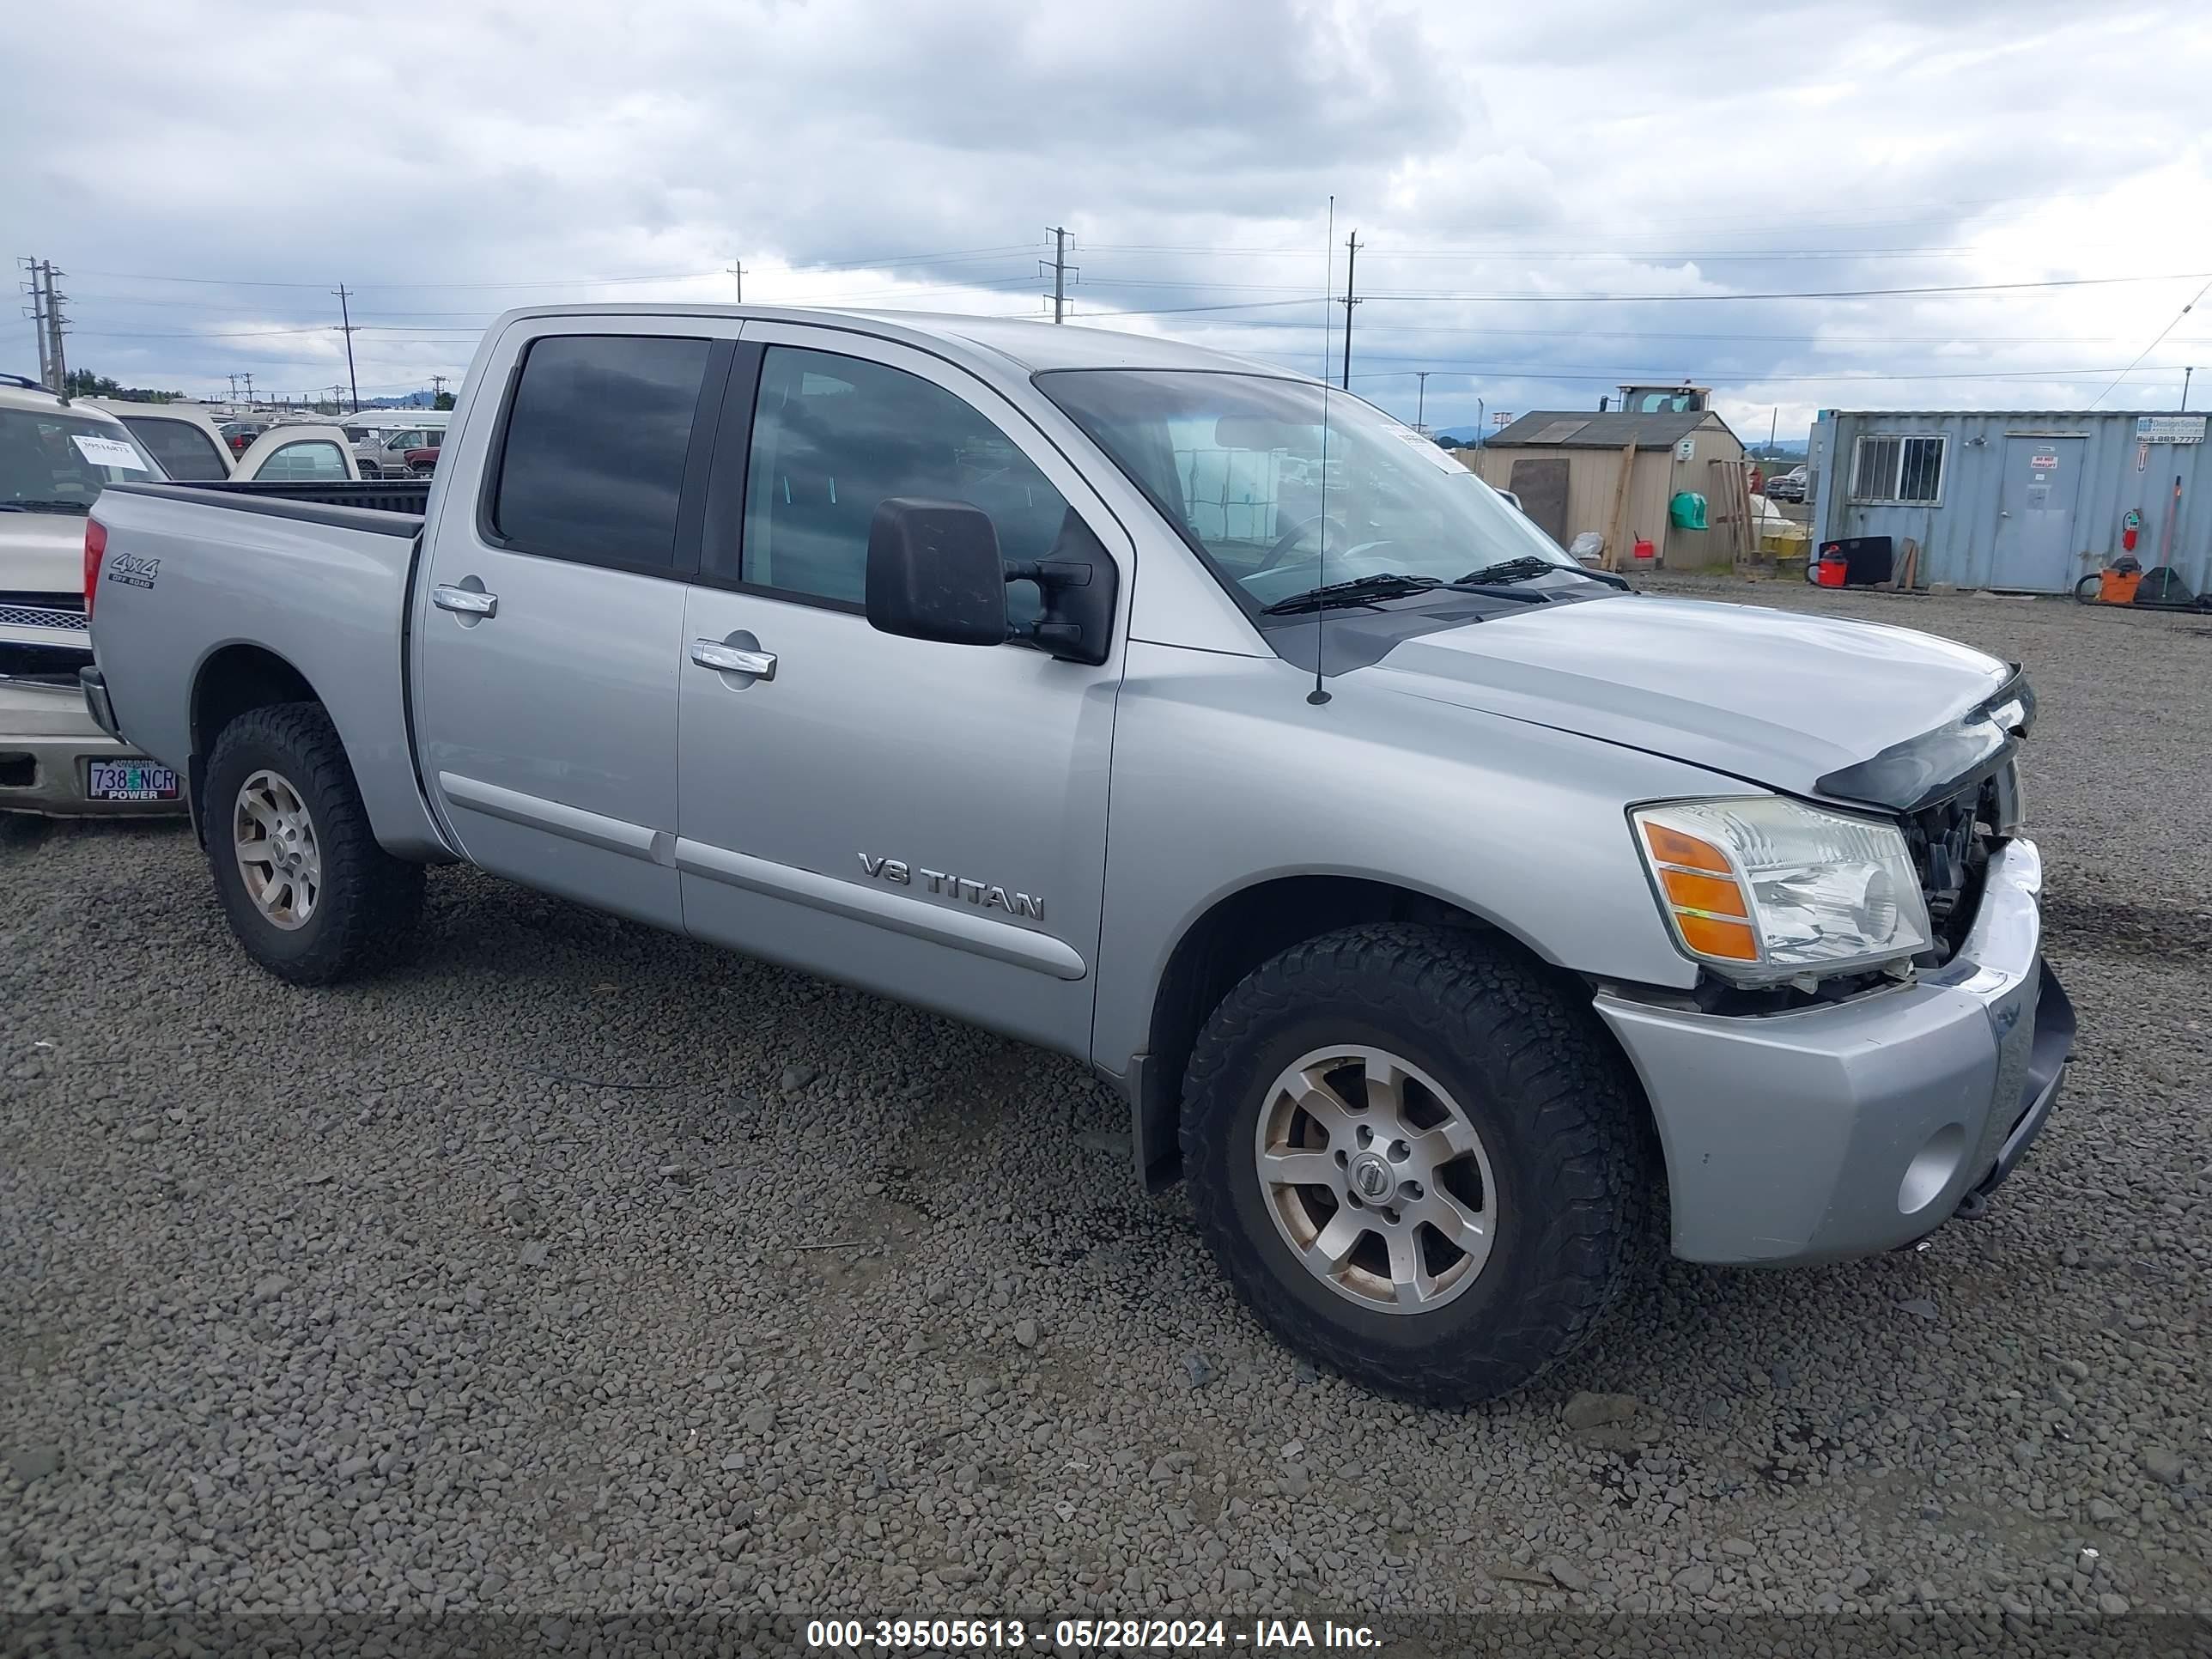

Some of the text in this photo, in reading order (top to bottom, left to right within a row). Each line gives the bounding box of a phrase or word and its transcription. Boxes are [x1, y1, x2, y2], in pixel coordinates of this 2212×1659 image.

[112, 574, 150, 588] OFF ROAD
[93, 769, 174, 789] 738 NCR
[108, 790, 158, 799] POWER
[858, 852, 1044, 921] V8 TITAN
